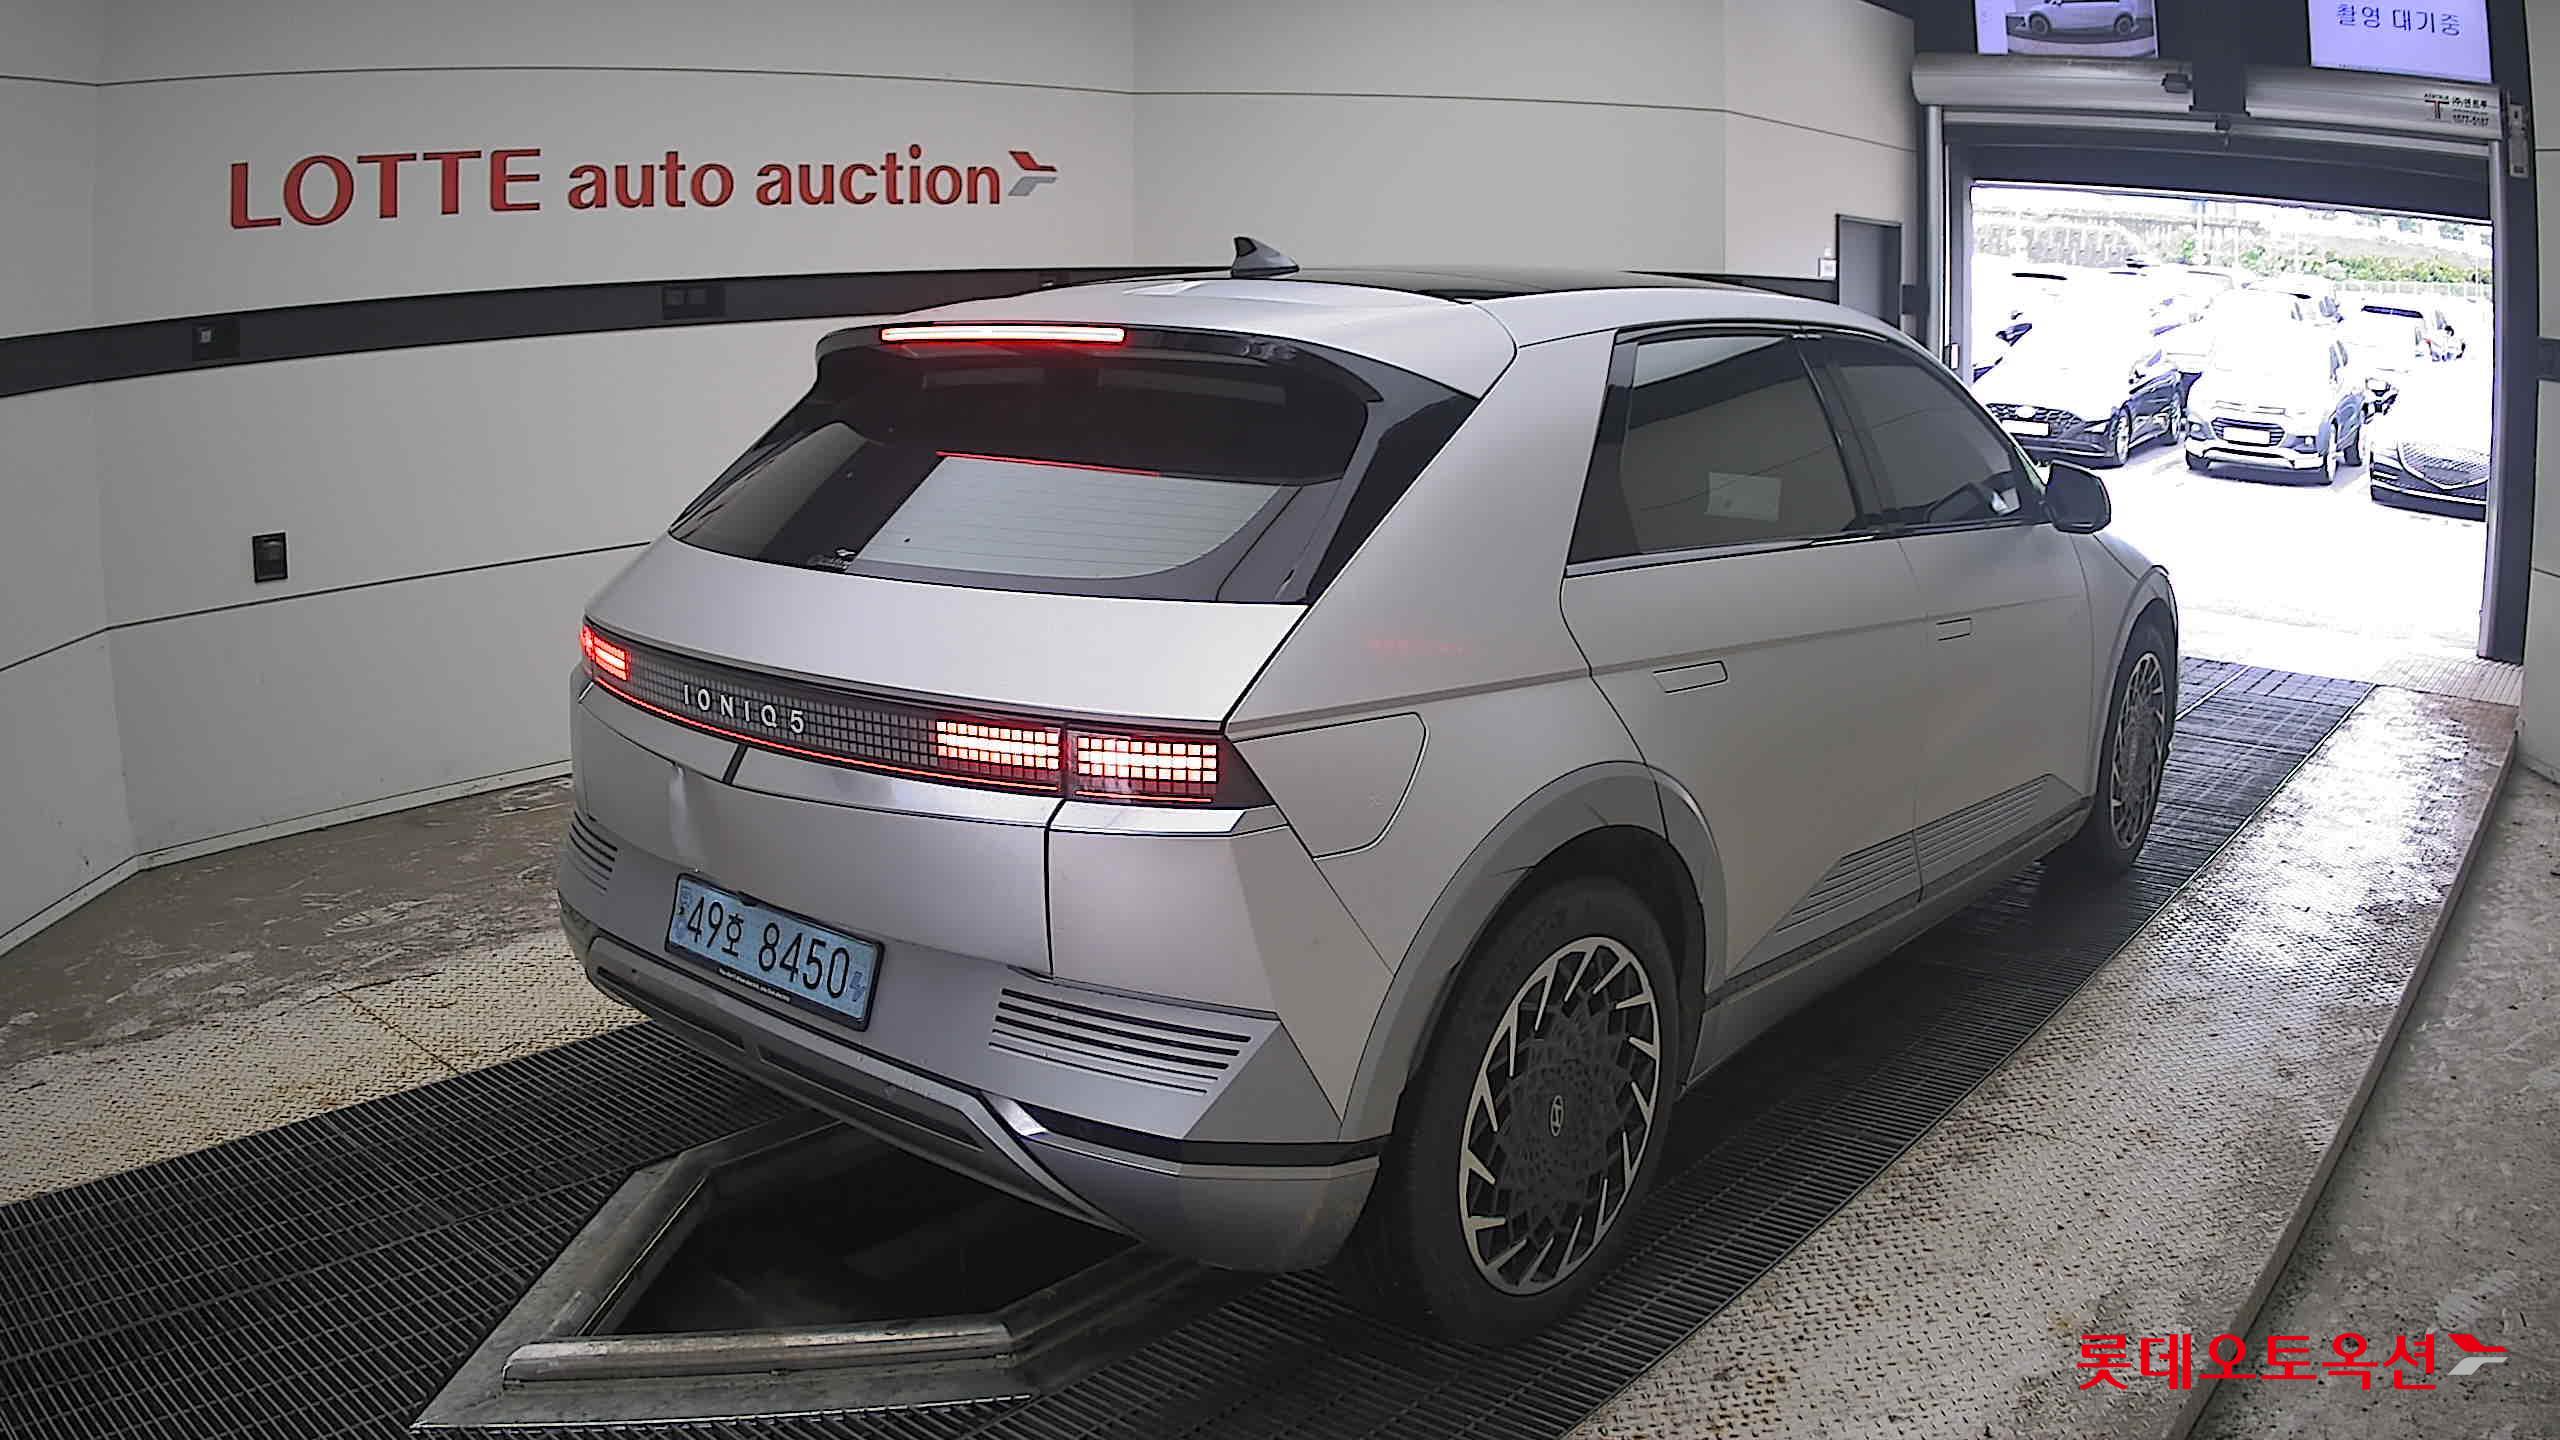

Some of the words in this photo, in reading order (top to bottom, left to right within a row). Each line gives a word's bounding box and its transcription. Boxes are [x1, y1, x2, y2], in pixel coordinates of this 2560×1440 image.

[2337, 3, 2381, 29] 촬영
[2392, 8, 2461, 37] 대기중
[229, 147, 541, 229] LOTTE
[567, 150, 735, 209] auto
[755, 143, 1001, 206] auction
[683, 684, 778, 728] IONIQ
[789, 709, 805, 734] 5
[687, 896, 744, 959] 49호
[758, 922, 850, 999] 8450
